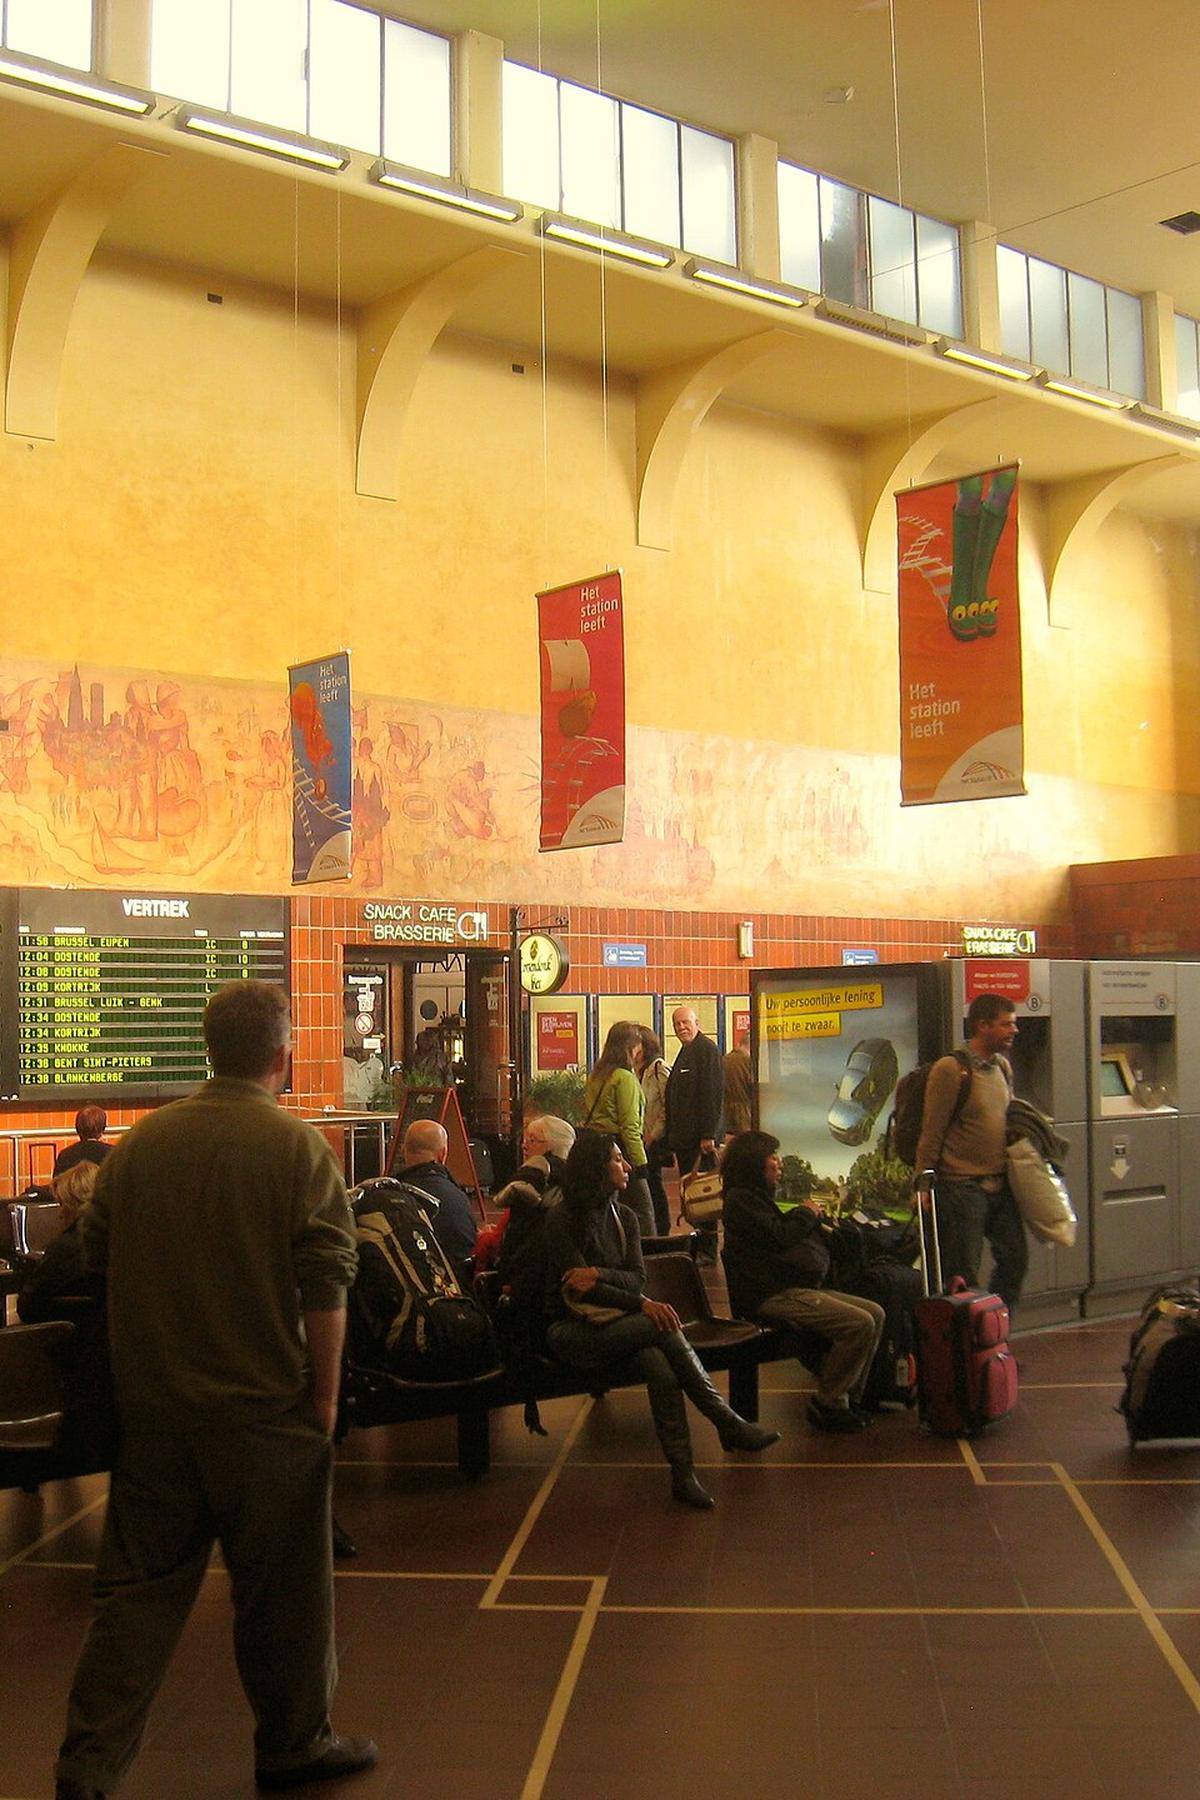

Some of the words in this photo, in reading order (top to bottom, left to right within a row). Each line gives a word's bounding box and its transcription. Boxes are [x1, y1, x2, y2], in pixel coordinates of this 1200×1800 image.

[581, 585, 600, 602] Het
[580, 598, 619, 618] station
[580, 615, 606, 634] leeft
[320, 663, 336, 677] Het
[319, 674, 347, 690] station
[319, 688, 339, 704] leeft
[909, 682, 936, 700] Het
[909, 699, 960, 720] station
[910, 719, 945, 739] leeft
[122, 898, 190, 918] VERTREK
[364, 903, 412, 920] SNACK
[419, 906, 457, 923] CAFE
[374, 924, 455, 943] BRASSERIE
[20, 936, 49, 947] 11:58
[54, 936, 95, 947] BRUSSEL
[100, 936, 130, 947] EUPEN
[205, 939, 217, 949] IC
[20, 951, 49, 962] 12:04
[54, 952, 101, 962] OOSTENDE
[205, 954, 217, 964] IC
[238, 954, 249, 964] 10
[20, 966, 49, 977] 12:08
[54, 967, 101, 977] OOSTENDE
[205, 969, 217, 978] IC
[20, 981, 49, 992] 12:09
[54, 982, 101, 993] KORTRIJK
[20, 997, 48, 1008] 12:31
[54, 997, 95, 1008] BRUSSEL
[100, 997, 124, 1008] LUIK
[766, 999, 780, 1010] Uw
[784, 990, 841, 1011] persoonlijke
[844, 990, 876, 1004] lening
[20, 1012, 49, 1022] 12:34
[54, 1012, 101, 1023] OOSTENDE
[20, 1027, 49, 1038] 12:34
[54, 1027, 101, 1038] KORTRIJK
[767, 1022, 789, 1033] nooit
[792, 1021, 802, 1032] te
[804, 1022, 836, 1032] zwaar.
[54, 1042, 90, 1053] KNOKKE
[54, 1058, 78, 1068] GENT
[83, 1056, 152, 1067] SINT-PIETERS
[54, 1072, 124, 1084] BLANKENBERGE
